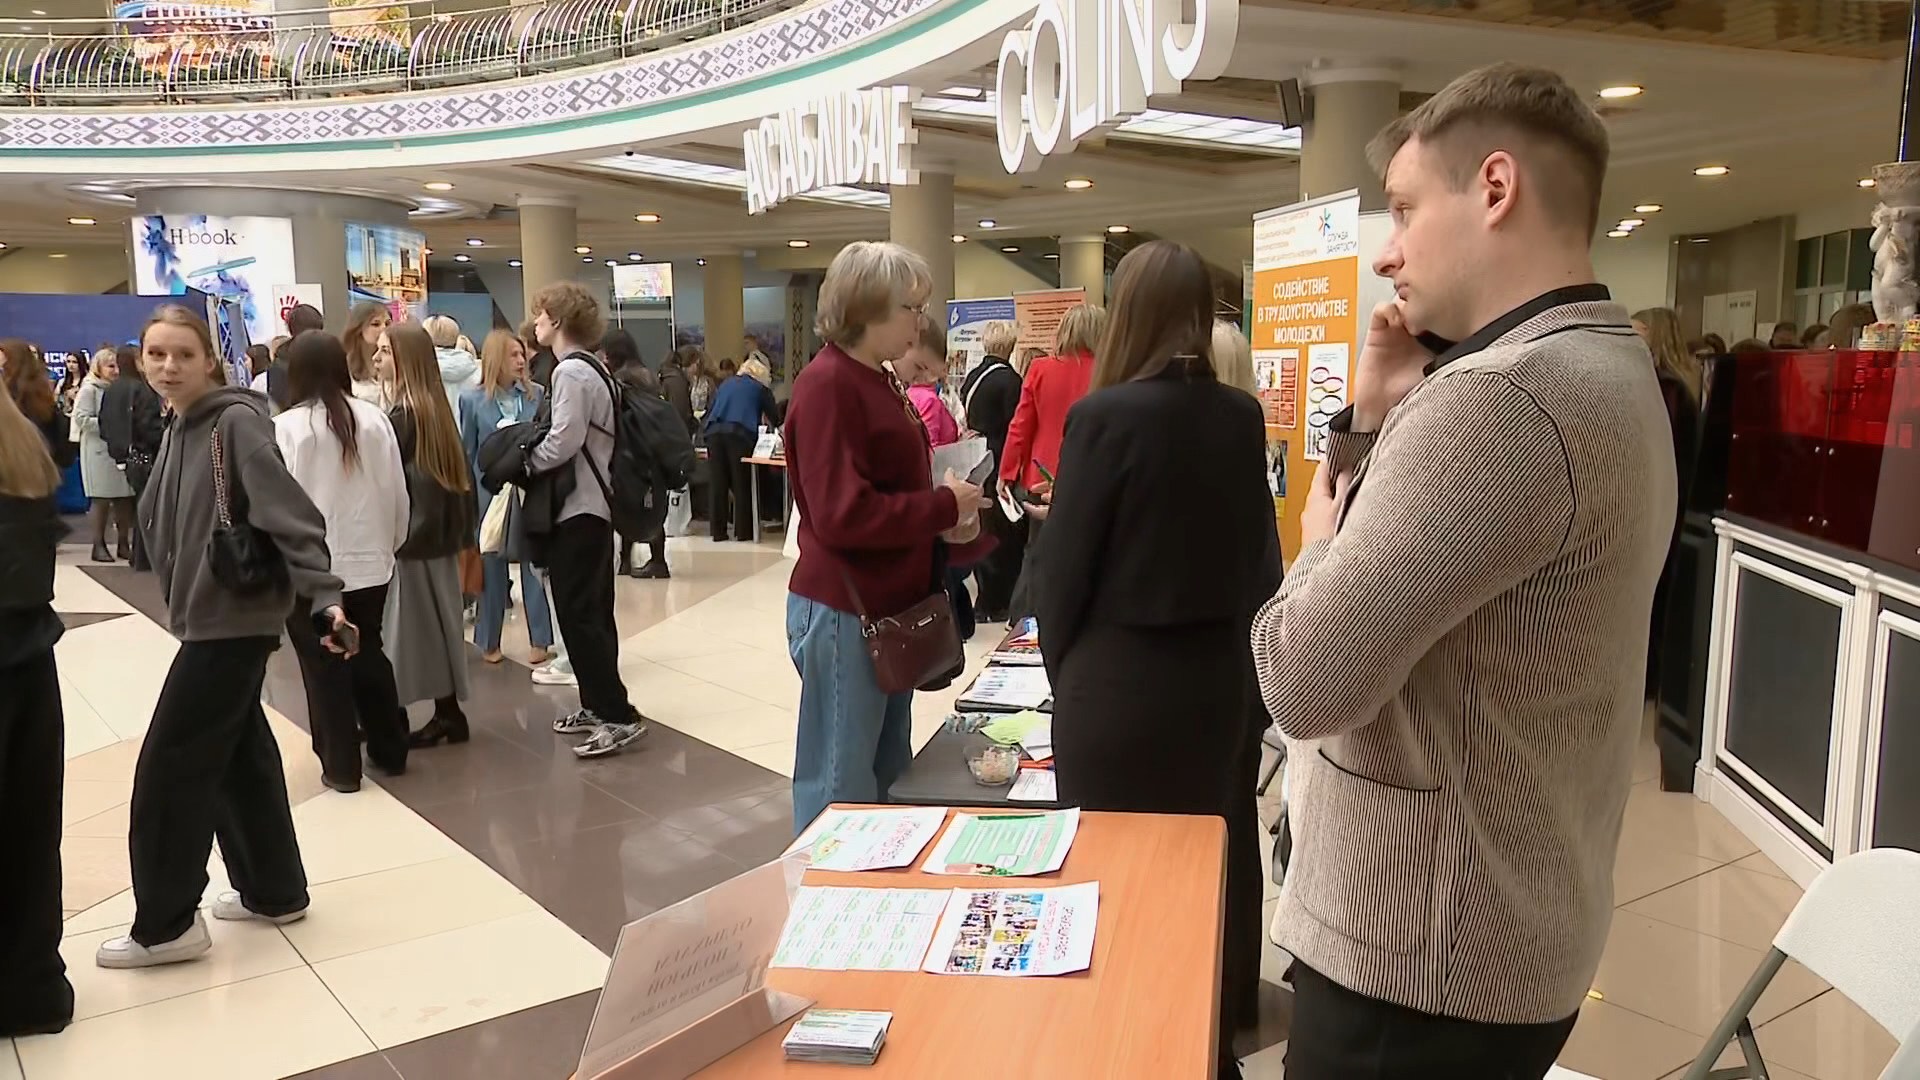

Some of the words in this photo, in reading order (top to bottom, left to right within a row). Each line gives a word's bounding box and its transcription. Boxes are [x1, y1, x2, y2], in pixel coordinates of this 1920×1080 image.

[1273, 277, 1330, 300] СОДЕЙСТВИЕ
[1257, 307, 1265, 323] В
[1265, 298, 1349, 323] ТРУДОУСТРОЙСТВЕ
[1273, 325, 1327, 344] МОЛОДЕЖИ
